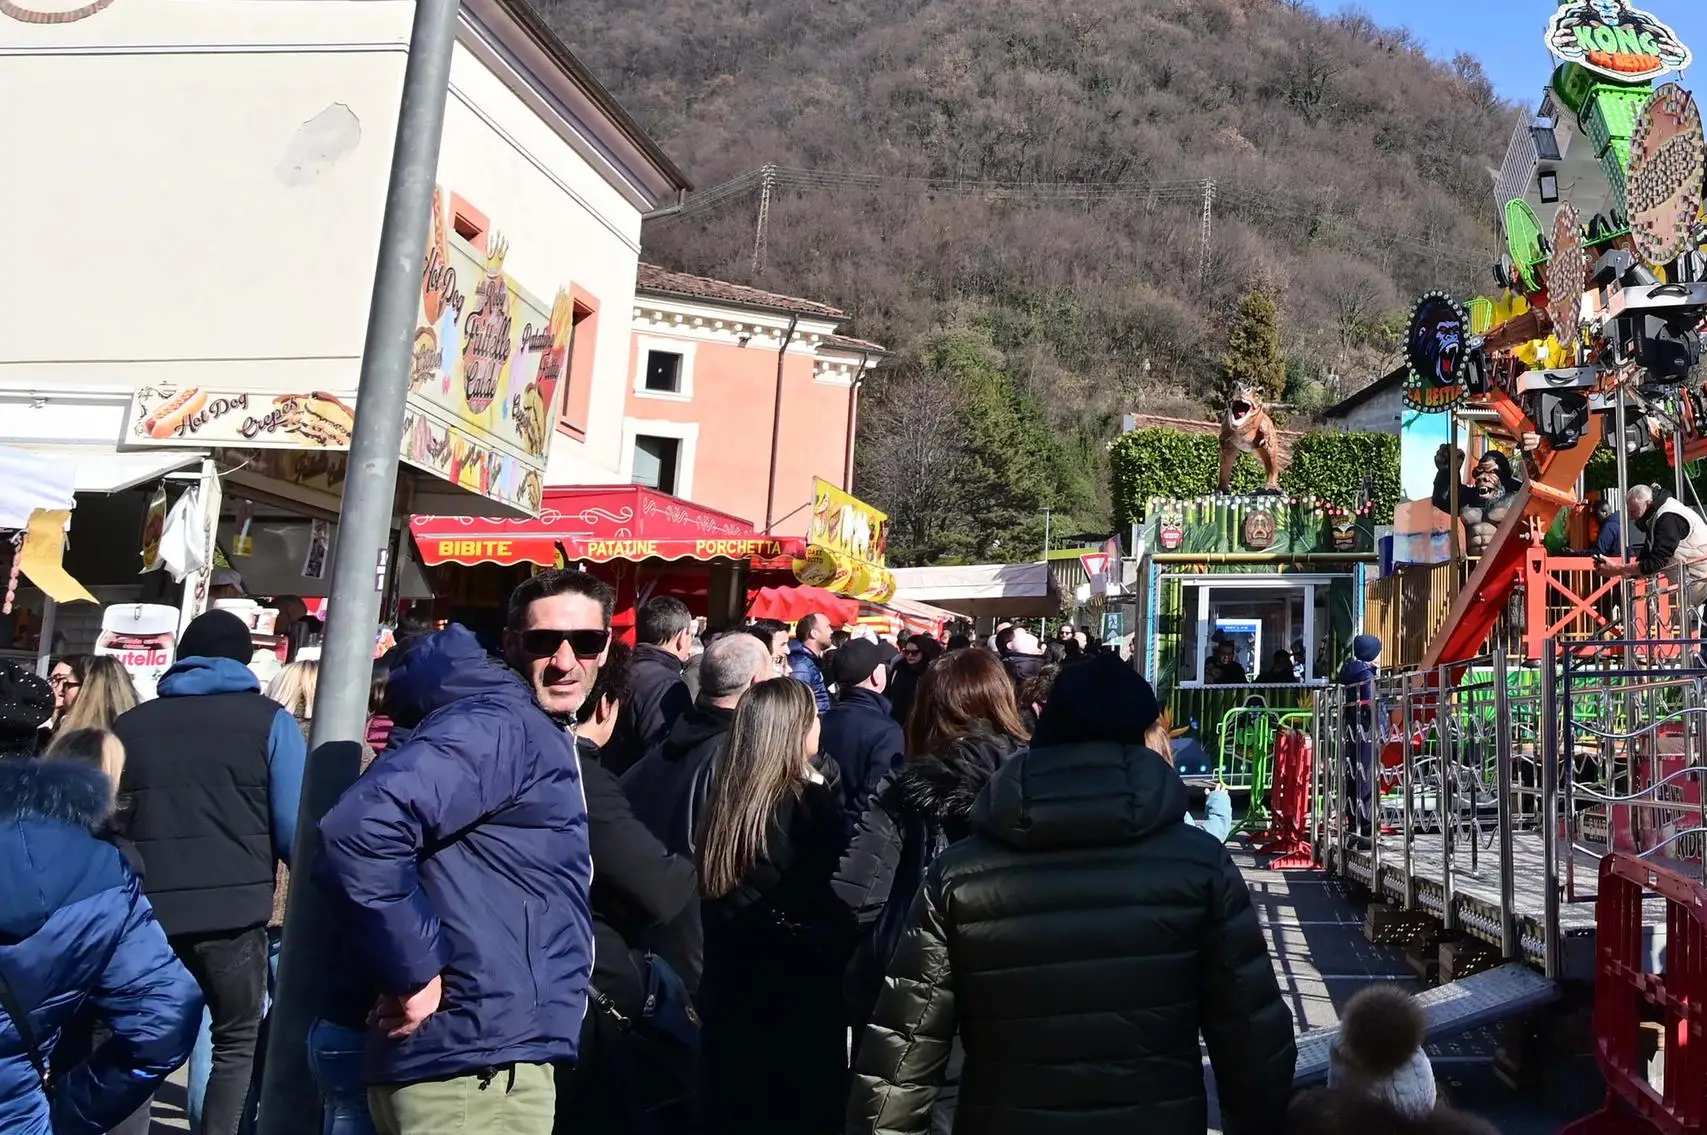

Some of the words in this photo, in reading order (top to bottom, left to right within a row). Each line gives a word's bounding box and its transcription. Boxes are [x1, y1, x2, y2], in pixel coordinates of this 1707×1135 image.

[1572, 24, 1661, 57] KONG
[174, 409, 209, 437] Hot
[208, 392, 250, 419] Dog
[438, 540, 513, 557] BIBITE
[587, 541, 658, 556] PATATINE
[696, 539, 782, 555] PORCHETTA
[114, 649, 168, 666] utella
